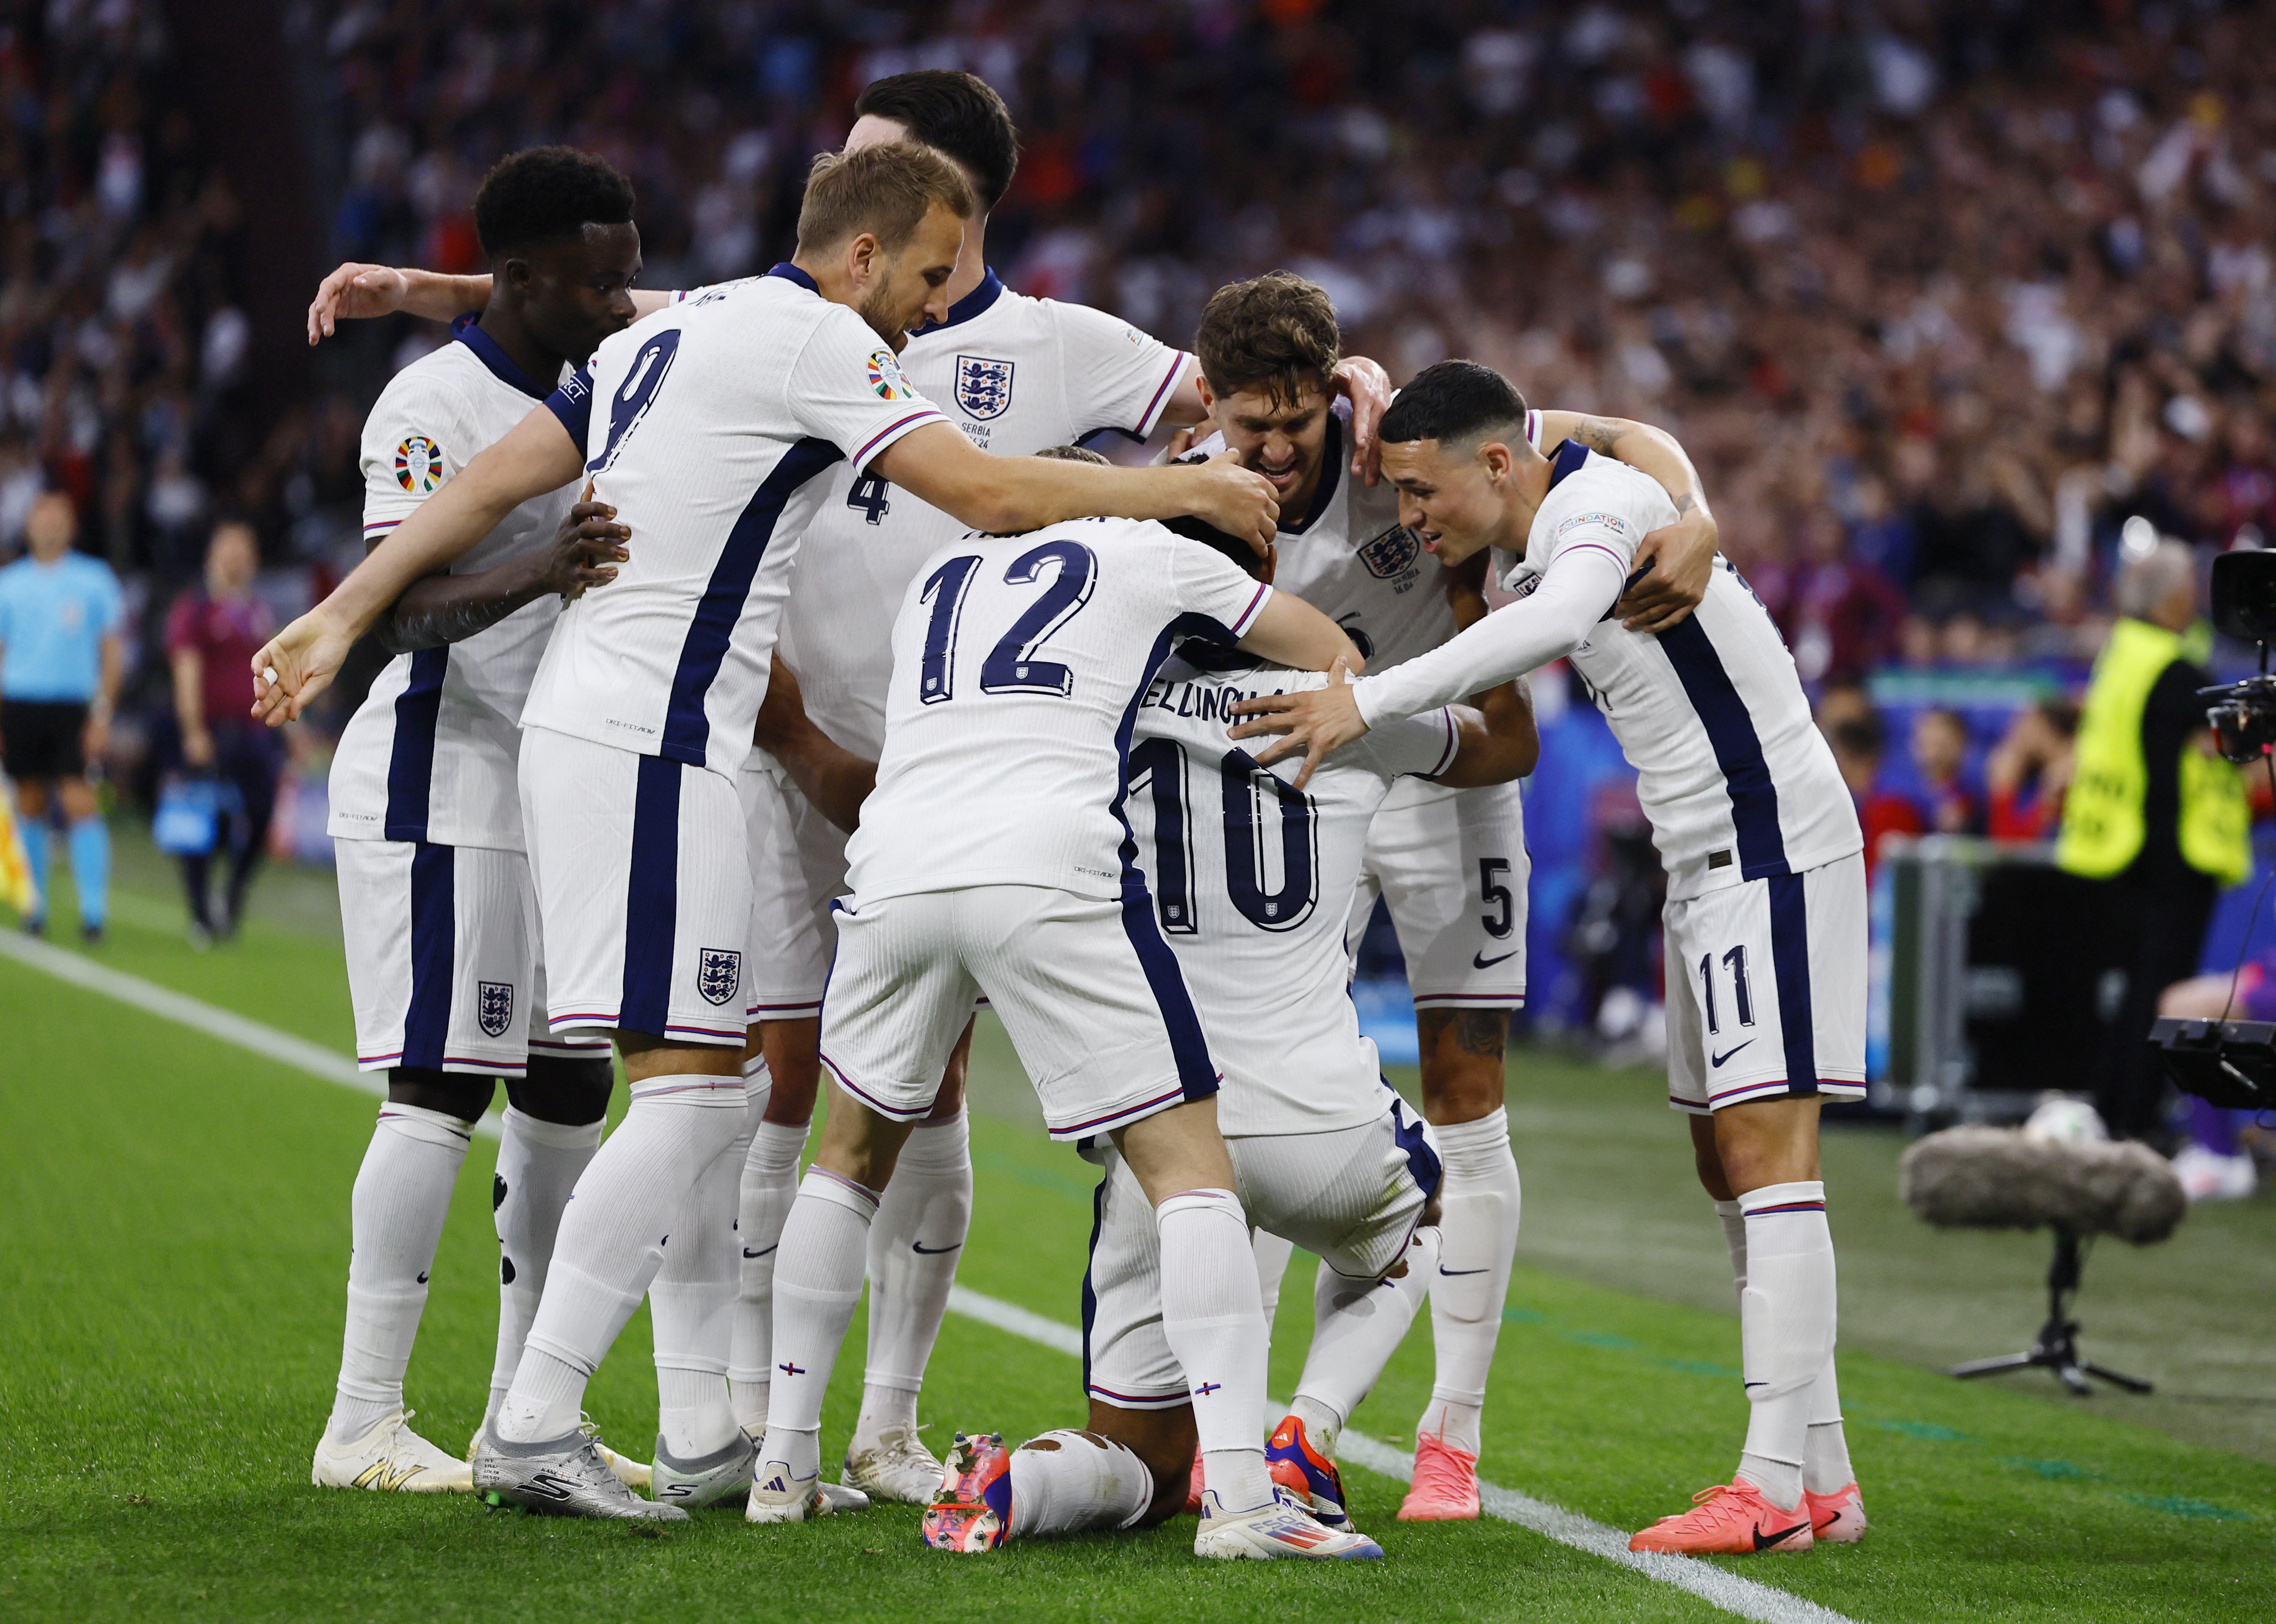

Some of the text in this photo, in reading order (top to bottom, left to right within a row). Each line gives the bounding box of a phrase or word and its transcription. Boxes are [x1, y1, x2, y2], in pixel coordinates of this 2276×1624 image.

[586, 329, 681, 478] 9
[961, 422, 990, 437] SERBIA
[847, 473, 890, 525] 4
[1559, 514, 1624, 534] FOUNDATION
[920, 539, 1098, 706] 12
[1128, 736, 1319, 934] 10
[1479, 857, 1515, 940] 5
[1700, 944, 1755, 1035] 11
